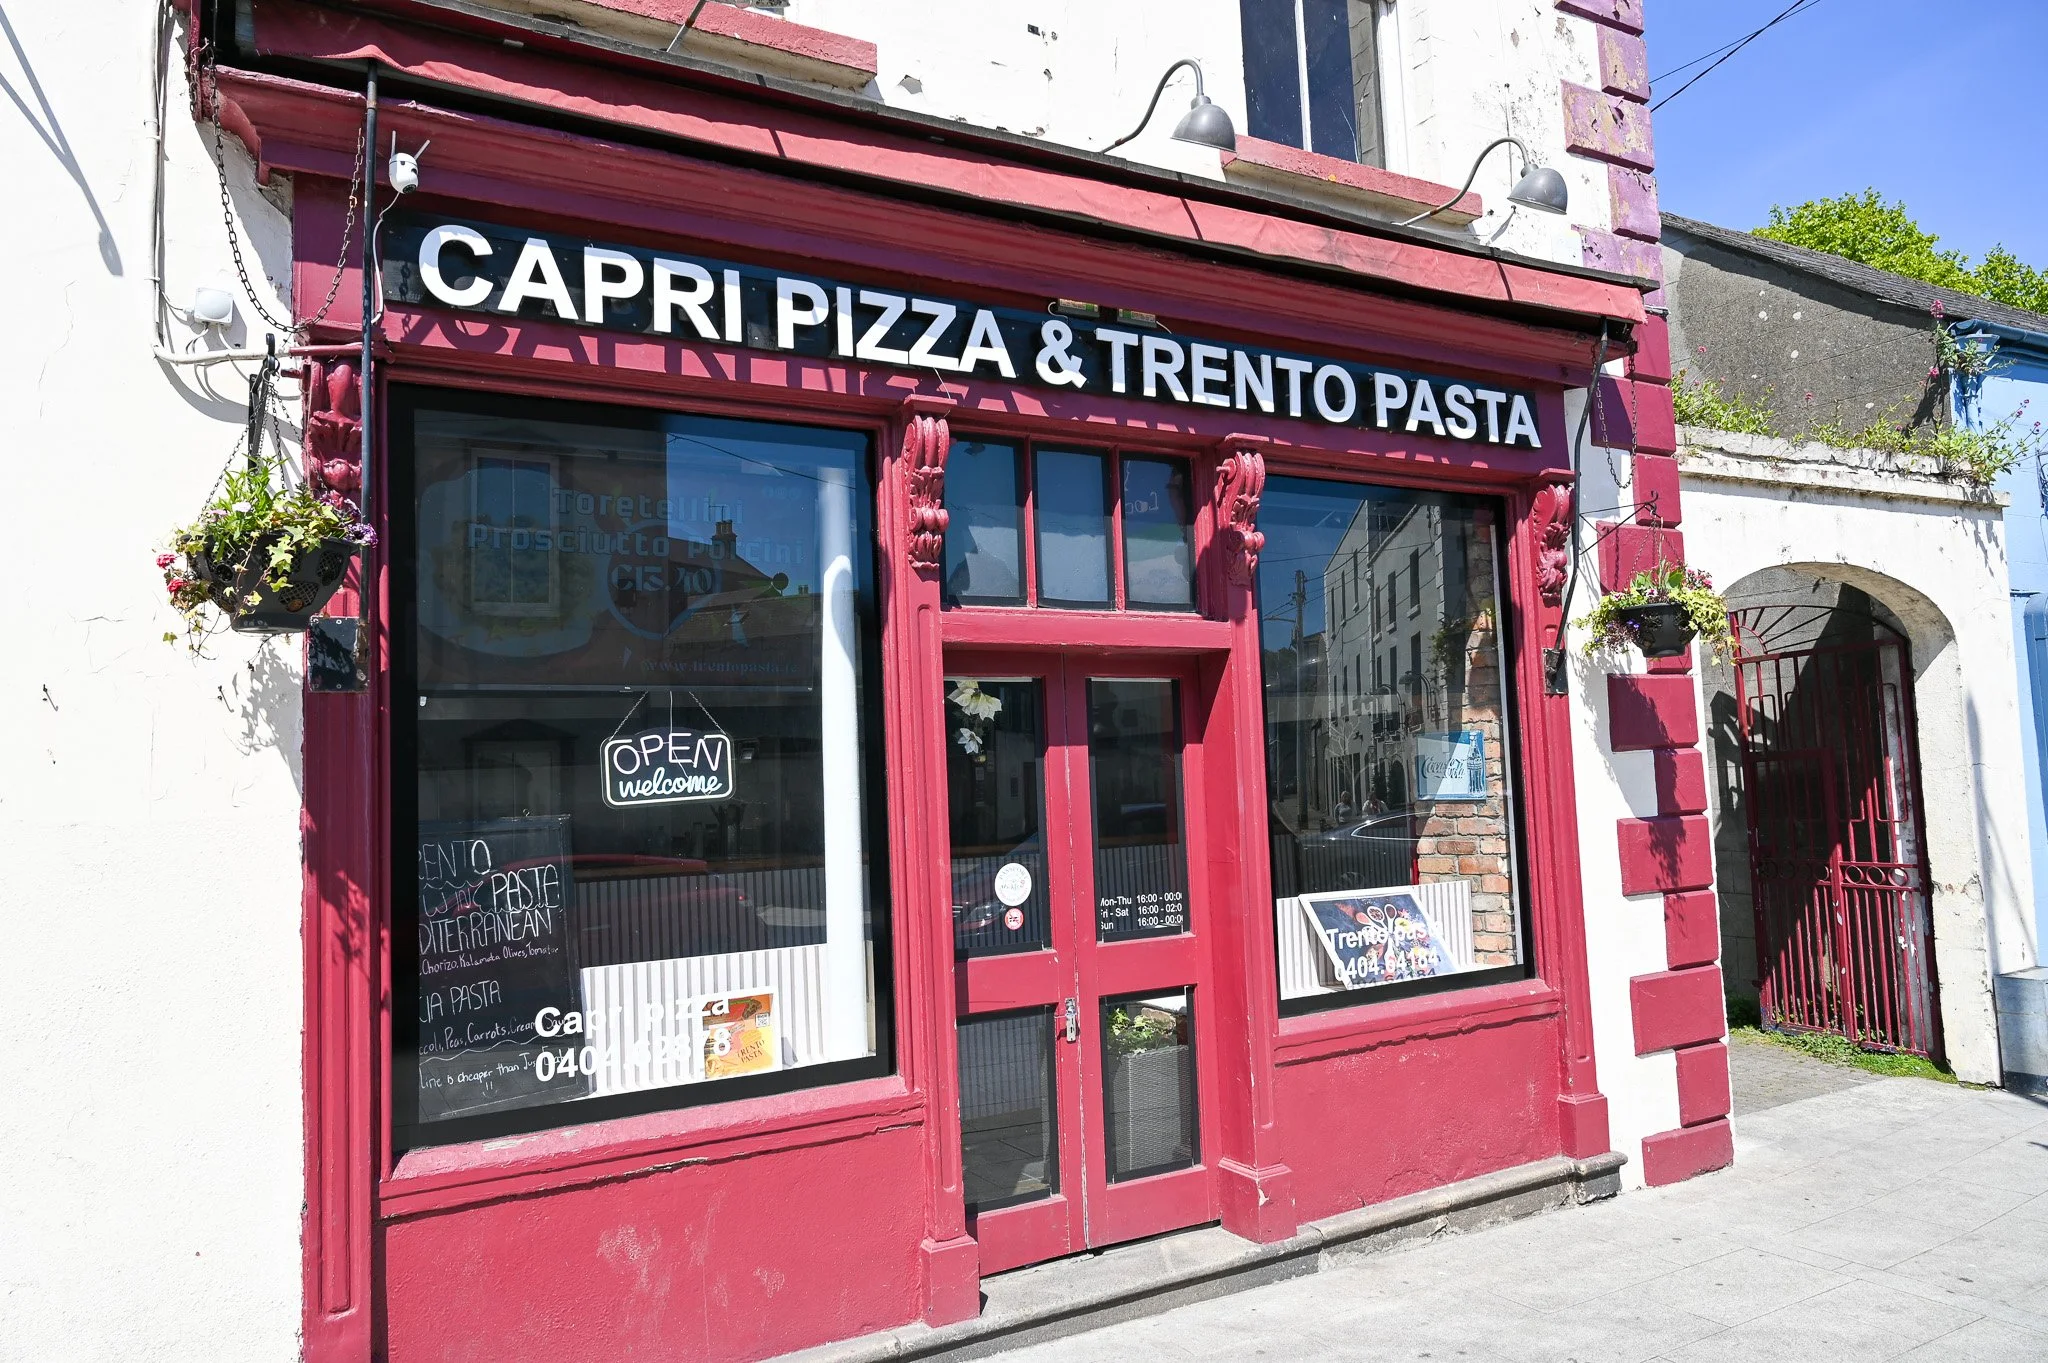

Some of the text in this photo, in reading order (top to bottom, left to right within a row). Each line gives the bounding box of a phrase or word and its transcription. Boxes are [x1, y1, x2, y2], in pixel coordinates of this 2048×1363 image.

[418, 224, 1542, 448] CAPRI PIZZA & TRENTO PASTA
[466, 522, 672, 559] Prosciutto
[613, 732, 723, 775] OPEN
[619, 767, 723, 798] welcome
[1100, 908, 1108, 918] ri
[1115, 907, 1129, 917] Sat
[1137, 905, 1159, 915] 16:00
[1136, 893, 1158, 904] 16:00
[1164, 891, 1183, 902] 00:0
[1137, 916, 1159, 926] 16:00
[1325, 925, 1389, 950] Trento
[450, 980, 502, 1015] PASTA
[496, 1062, 519, 1077] than
